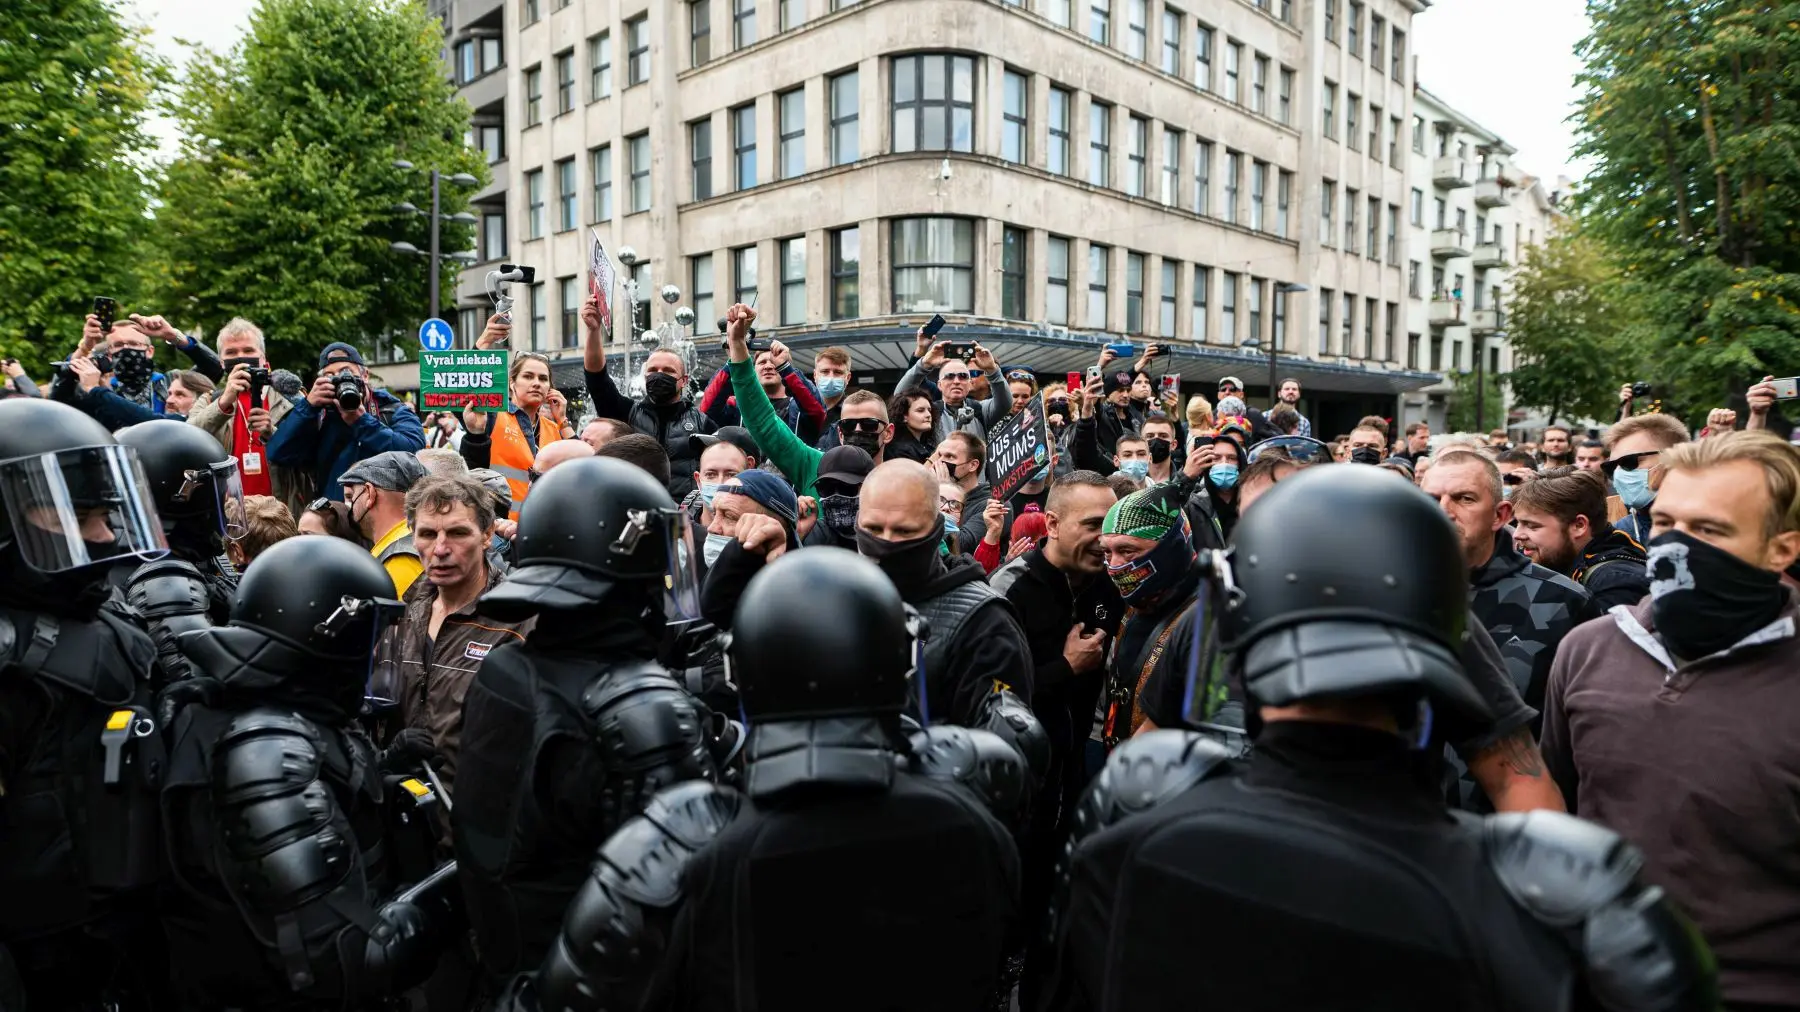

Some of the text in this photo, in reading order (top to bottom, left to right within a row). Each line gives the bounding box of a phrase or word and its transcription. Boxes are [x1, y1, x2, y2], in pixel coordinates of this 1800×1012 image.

[424, 353, 502, 368] Vyrai niekada
[433, 372, 493, 388] NEBUS
[424, 392, 503, 407] MOTERYS!
[989, 434, 1010, 463] JŪS
[996, 427, 1036, 479] MUMS
